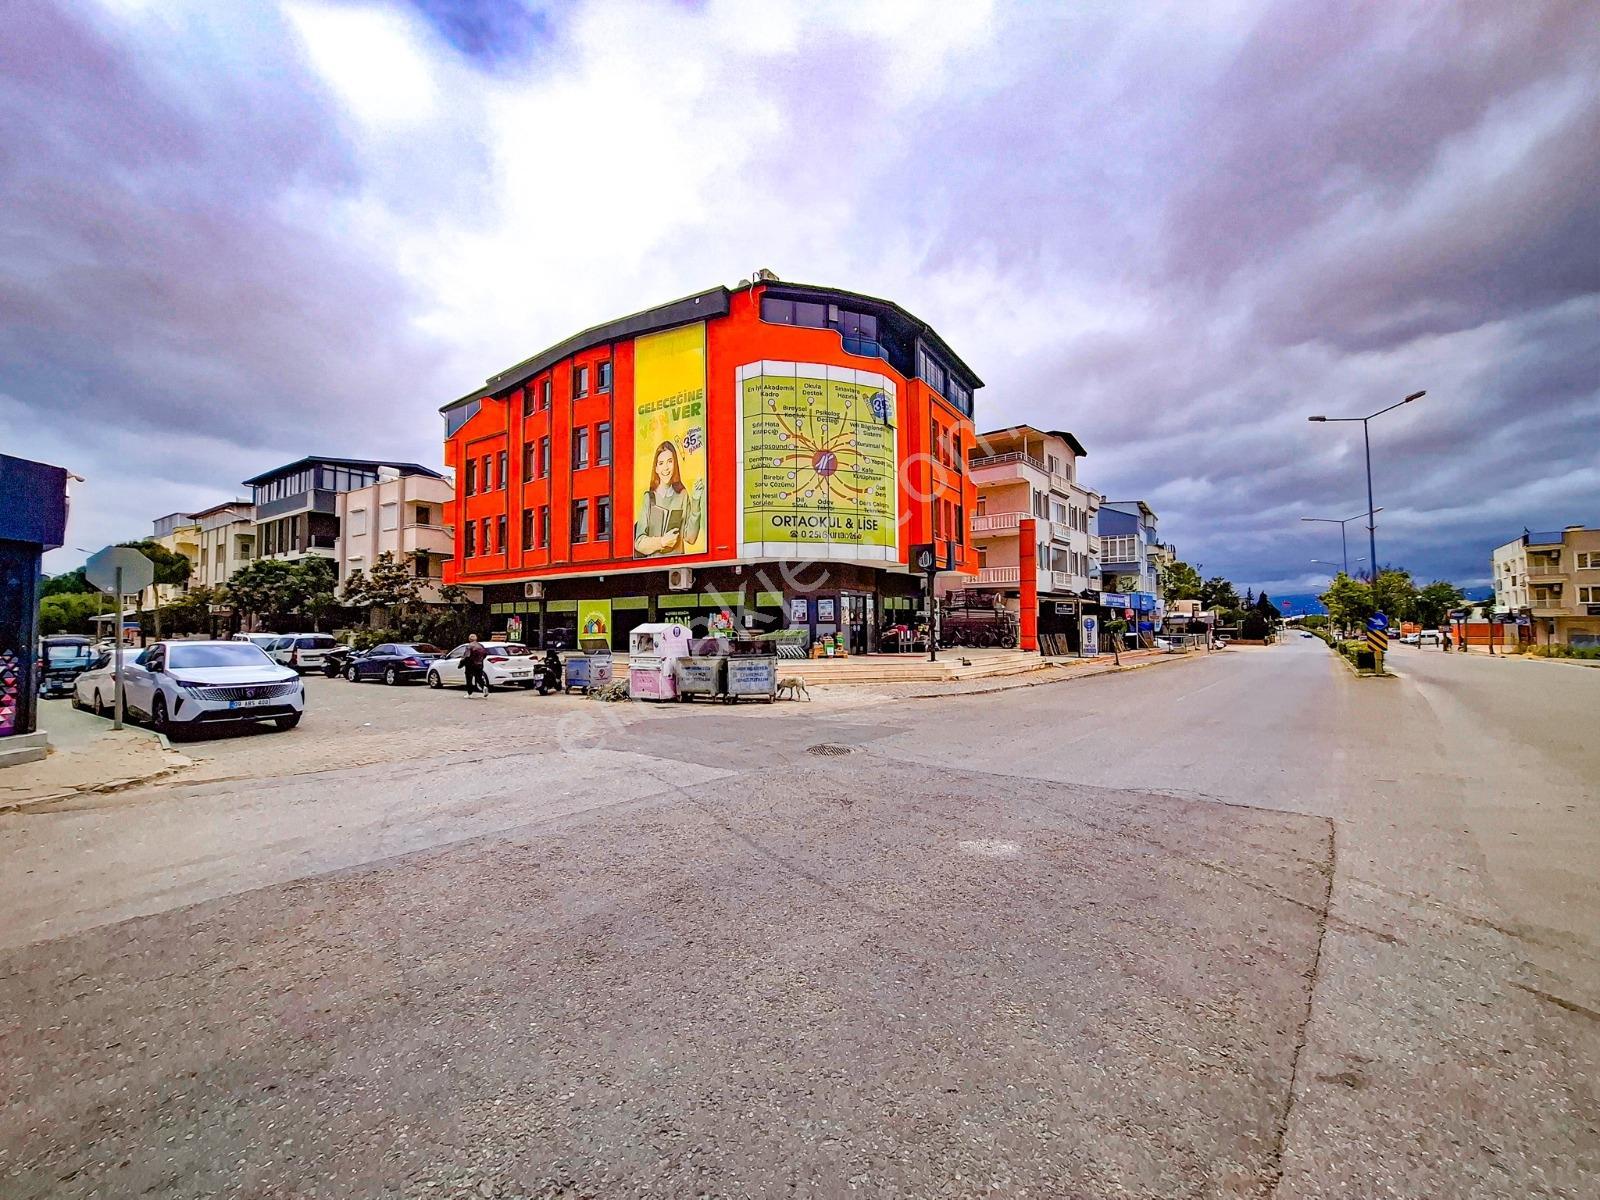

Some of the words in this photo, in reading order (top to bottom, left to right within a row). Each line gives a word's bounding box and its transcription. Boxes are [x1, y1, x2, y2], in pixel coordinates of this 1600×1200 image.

[638, 388, 703, 415] GELECEĞİNE
[672, 402, 701, 421] VER
[684, 434, 696, 449] 35
[771, 515, 842, 529] ORTAOKUL
[845, 518, 854, 529] &
[858, 517, 879, 531] LİSE
